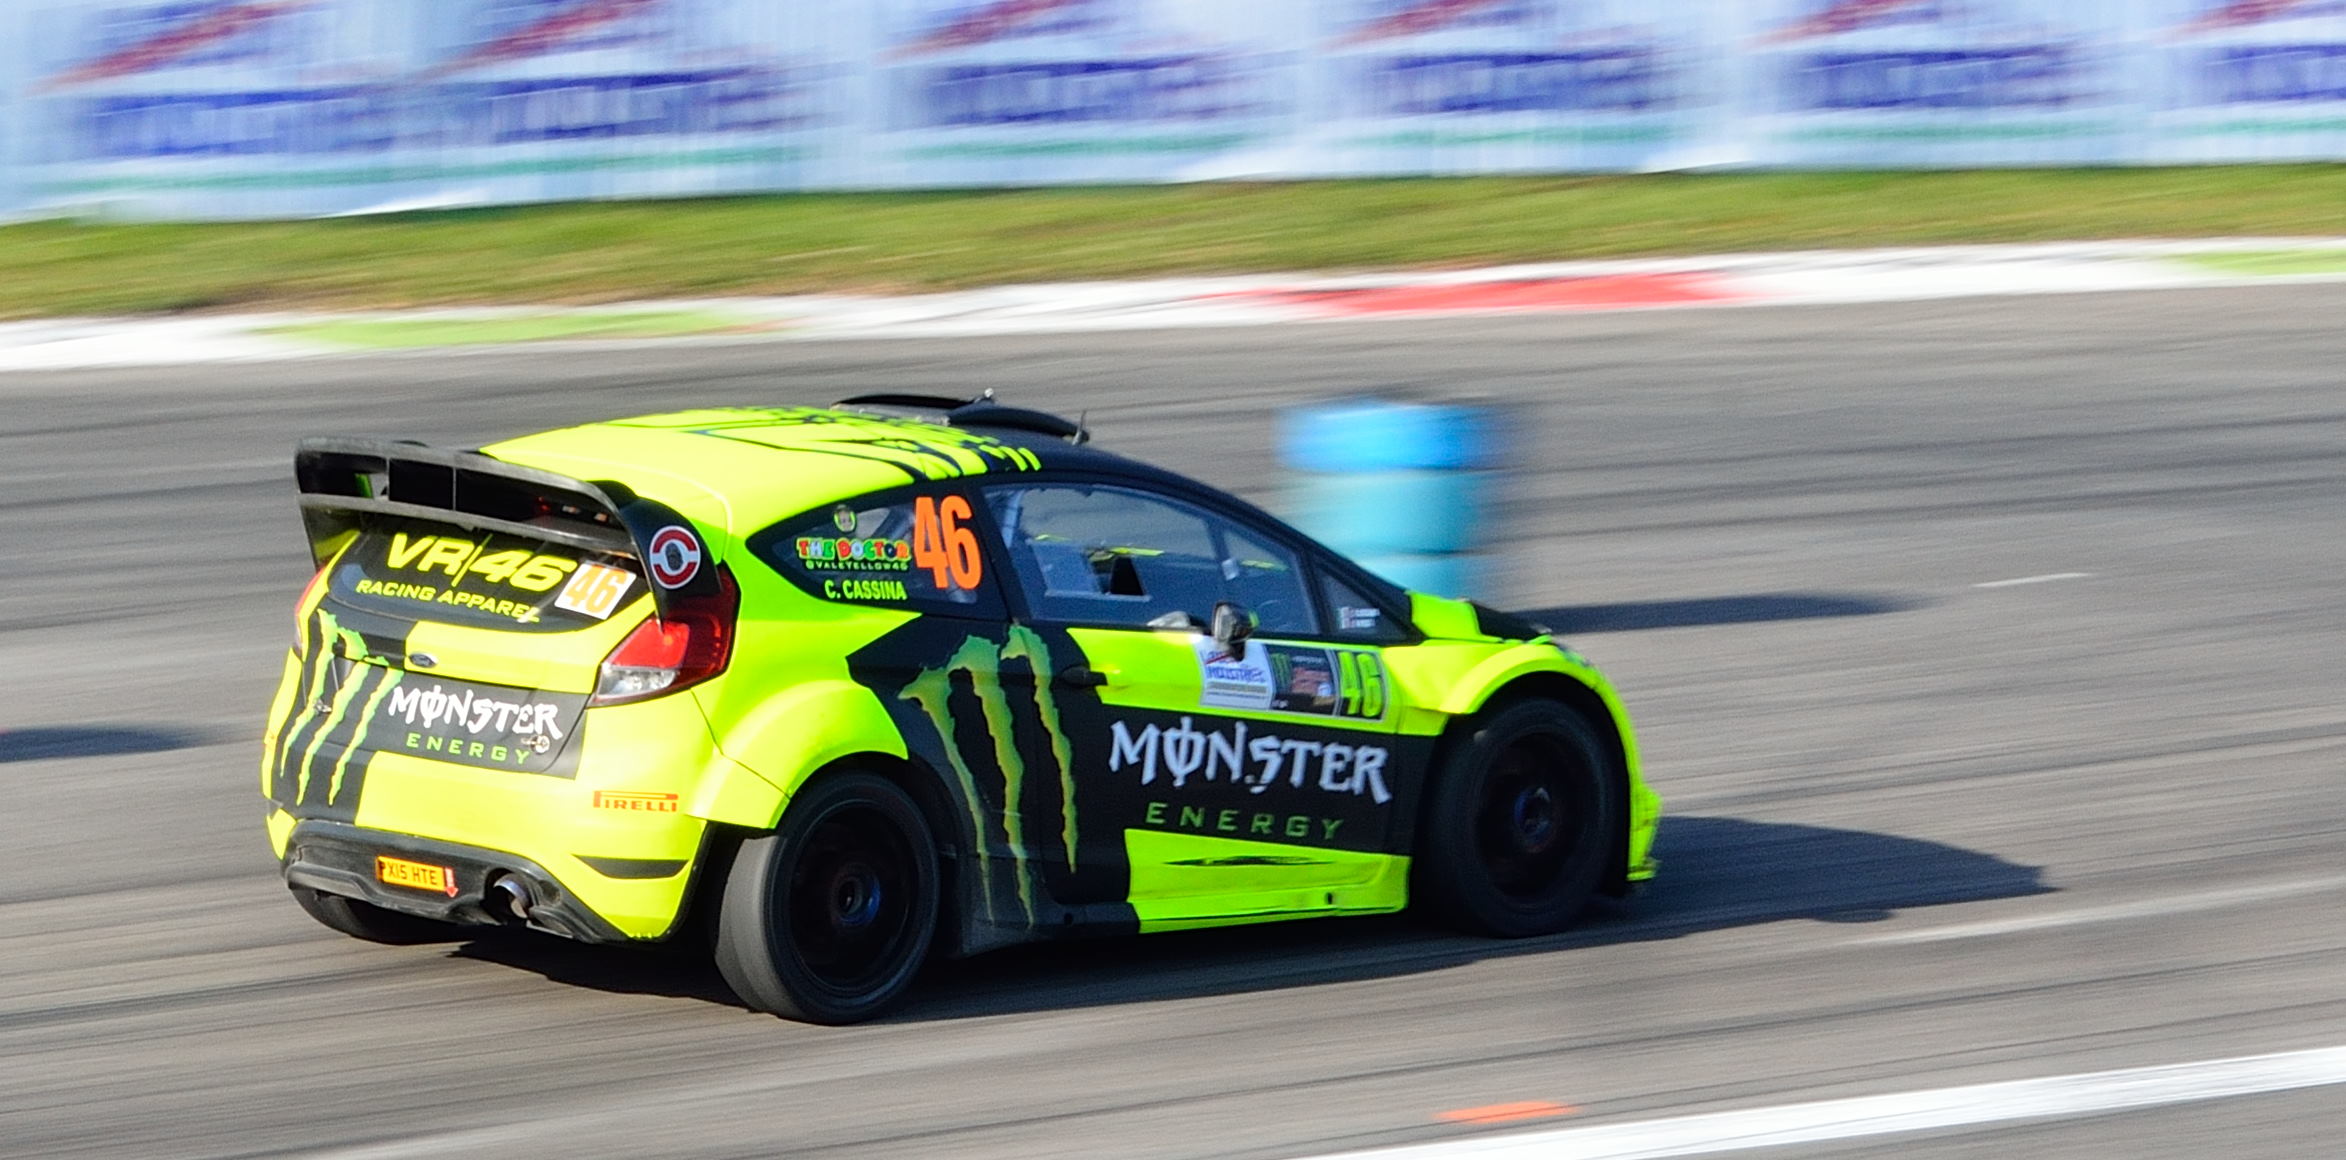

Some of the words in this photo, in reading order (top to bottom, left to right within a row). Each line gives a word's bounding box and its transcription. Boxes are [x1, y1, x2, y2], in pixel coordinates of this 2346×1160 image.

[797, 538, 835, 560] THE
[836, 538, 911, 561] DOCTOR
[914, 495, 982, 590] 46
[806, 561, 908, 572] @VALEYELLOW46
[355, 579, 437, 602] RACING
[437, 590, 541, 624] APPAREL
[565, 562, 628, 614] 46
[824, 580, 841, 599] C.
[842, 580, 908, 600] CASSINA
[1337, 651, 1382, 718] 46
[406, 733, 531, 765] ENERGY
[593, 791, 678, 812] PIRELLI
[1145, 801, 1344, 840] ENERGY
[412, 866, 438, 885] HTE
